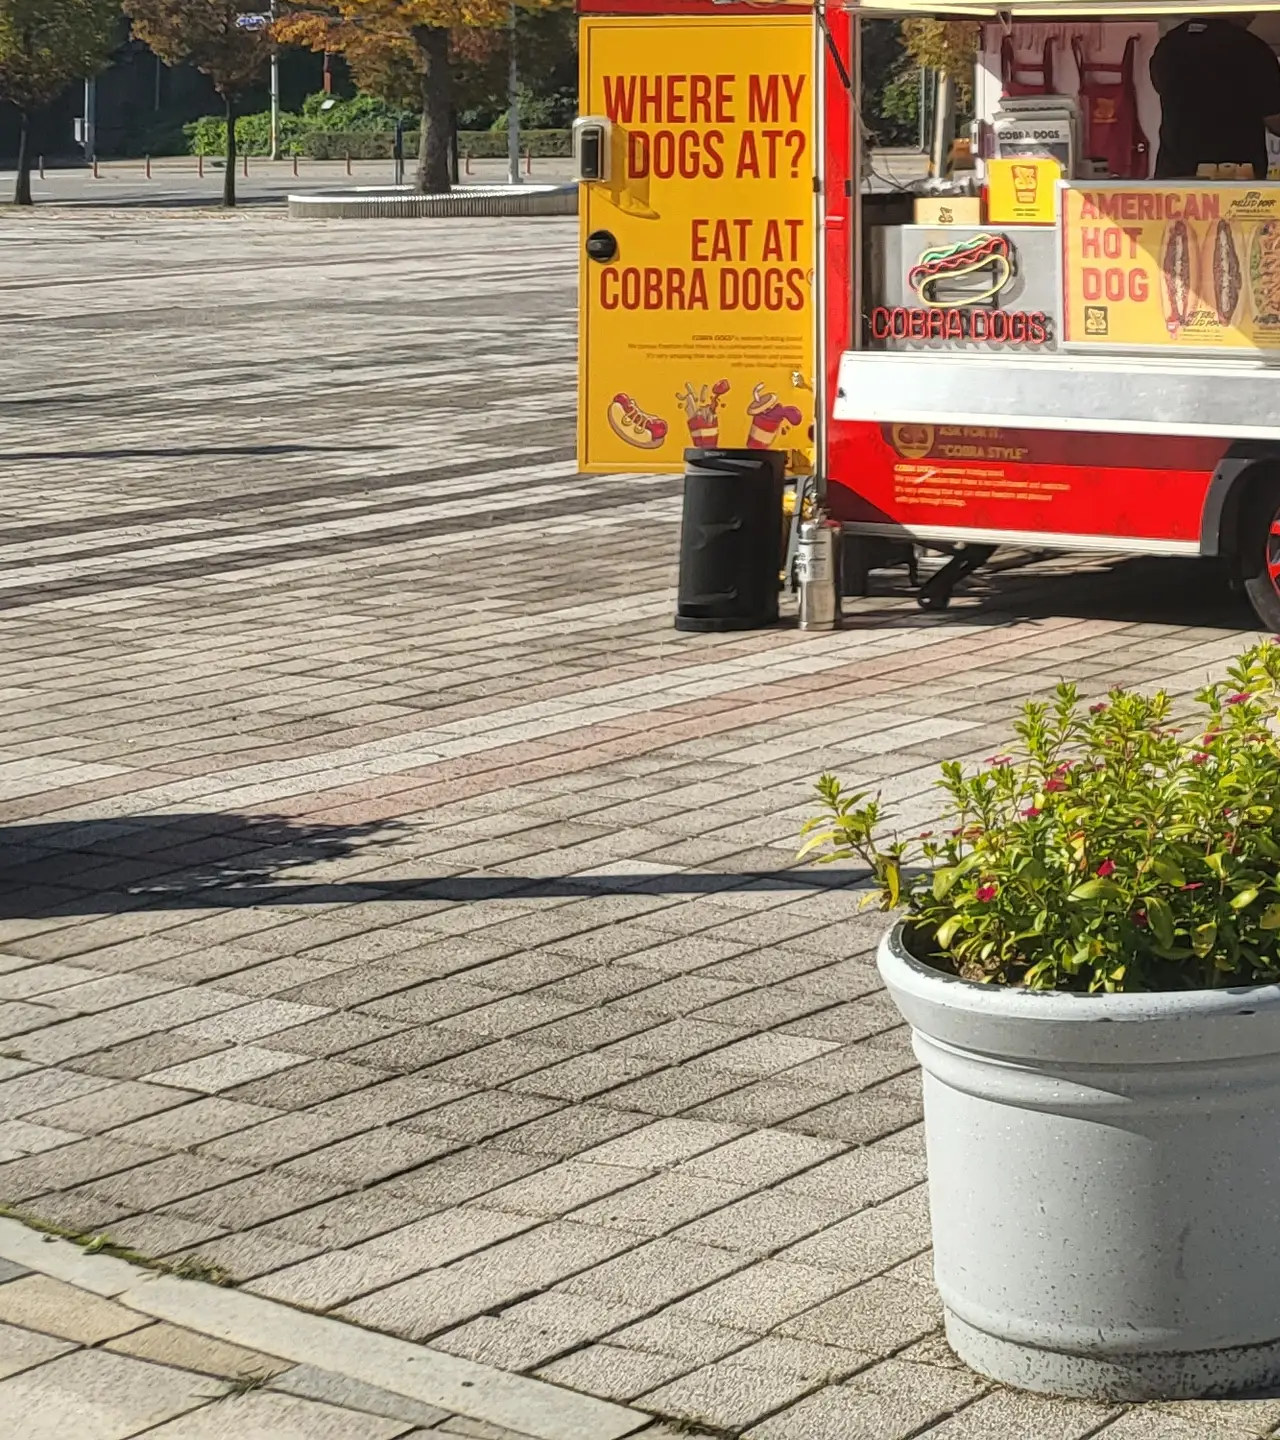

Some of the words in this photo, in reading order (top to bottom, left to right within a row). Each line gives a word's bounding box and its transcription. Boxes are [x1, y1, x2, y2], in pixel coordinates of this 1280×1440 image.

[603, 74, 735, 124] WHERE
[749, 74, 806, 123] MY
[998, 130, 1032, 140] COBRA
[1033, 130, 1060, 139] DOGS
[628, 130, 724, 179] DOGS
[736, 130, 806, 179] AT?
[1080, 192, 1221, 221] AMERICAN
[692, 219, 753, 261] EAT
[762, 219, 804, 261] AT
[1082, 227, 1143, 260] HOT
[600, 267, 709, 311] COBRA
[720, 267, 805, 311] DOGS
[1082, 268, 1150, 302] DOG
[872, 307, 963, 341] COBRA
[970, 308, 1047, 344] DOGS
